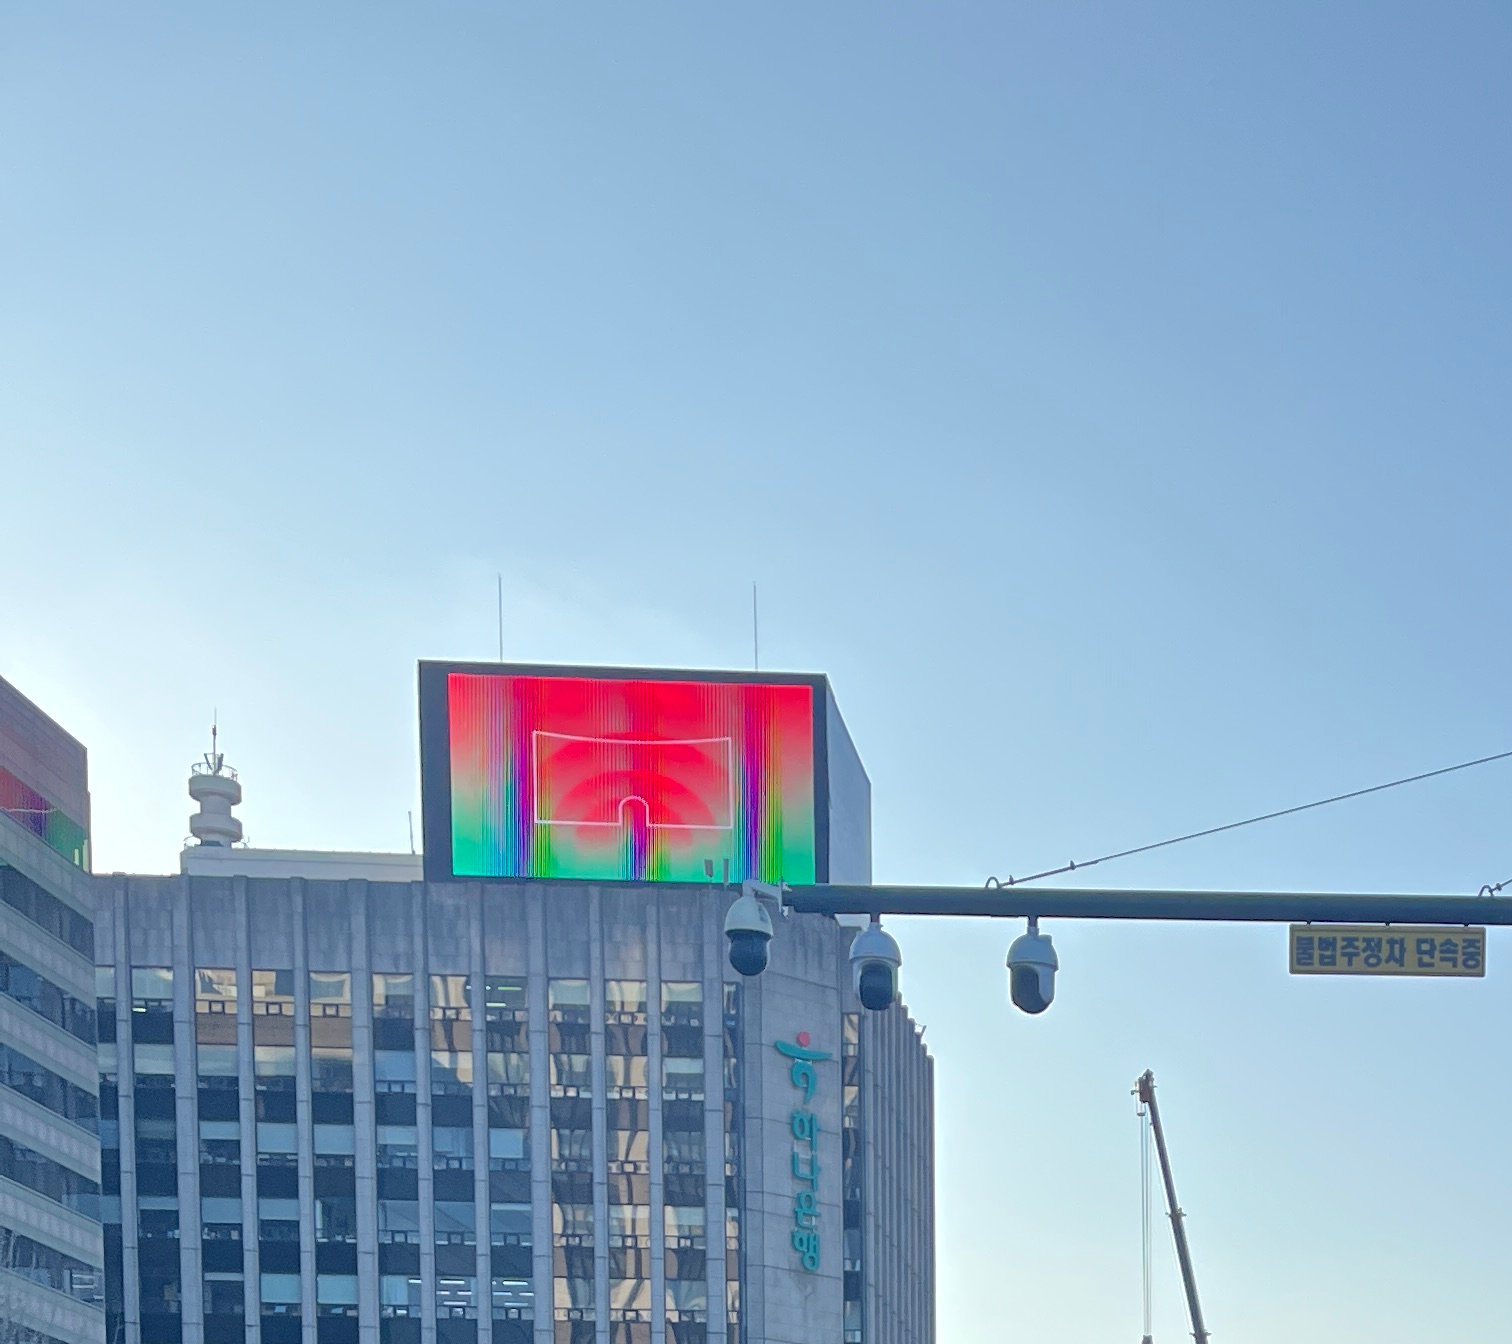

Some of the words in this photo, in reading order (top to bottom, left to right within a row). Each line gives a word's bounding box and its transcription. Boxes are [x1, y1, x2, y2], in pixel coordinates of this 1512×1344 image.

[1295, 935, 1407, 968] 불법주정차
[1415, 937, 1482, 969] 단속중
[791, 1109, 822, 1273] 하나은행
